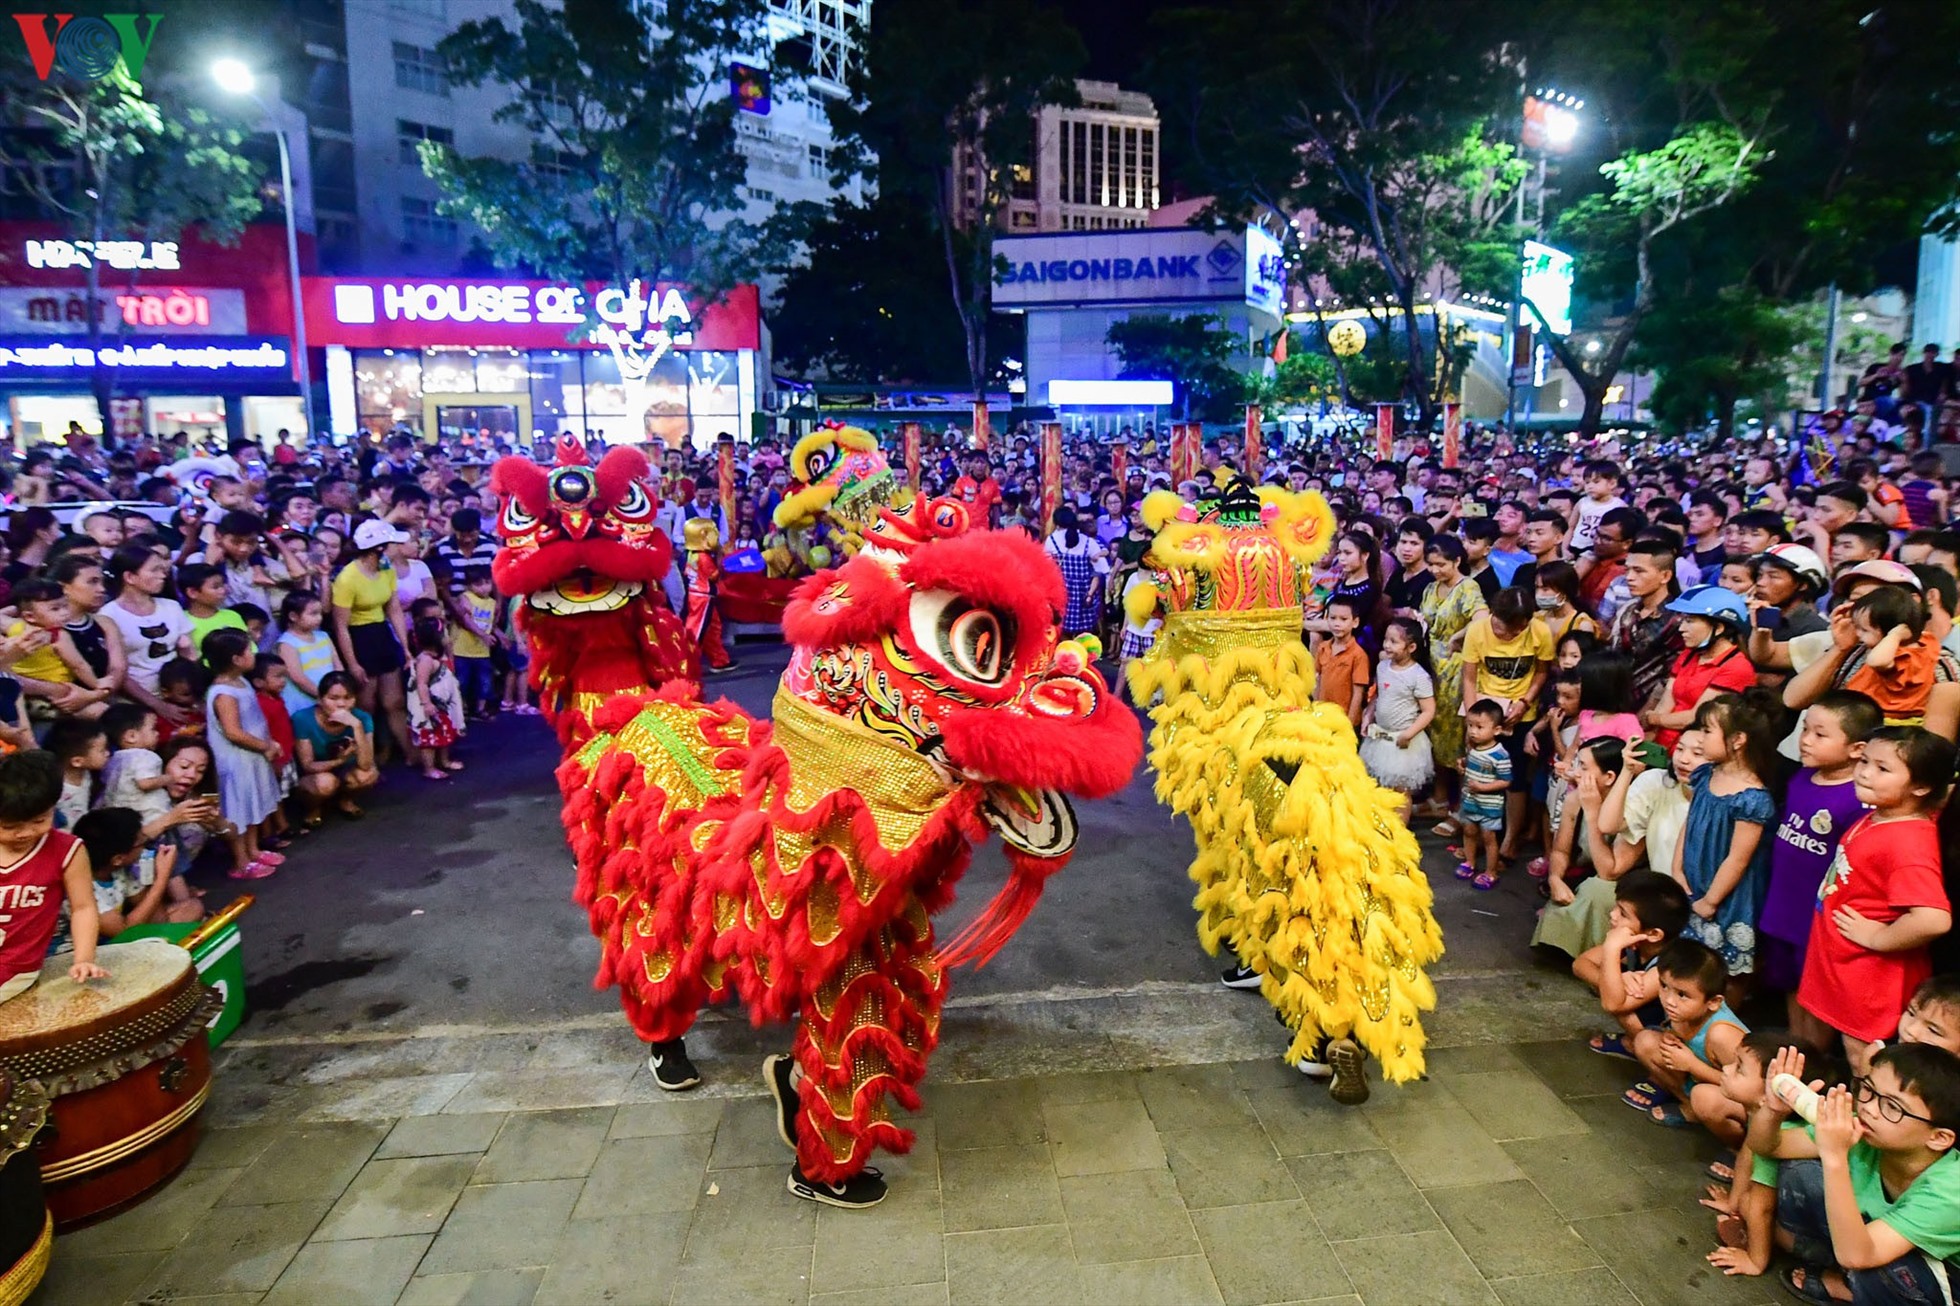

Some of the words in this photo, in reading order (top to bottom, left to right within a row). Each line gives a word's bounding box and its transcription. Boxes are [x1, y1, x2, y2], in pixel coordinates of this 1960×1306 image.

[1001, 254, 1201, 284] SAIGONBANK
[383, 284, 532, 323] HOUSE
[535, 287, 587, 323] OF
